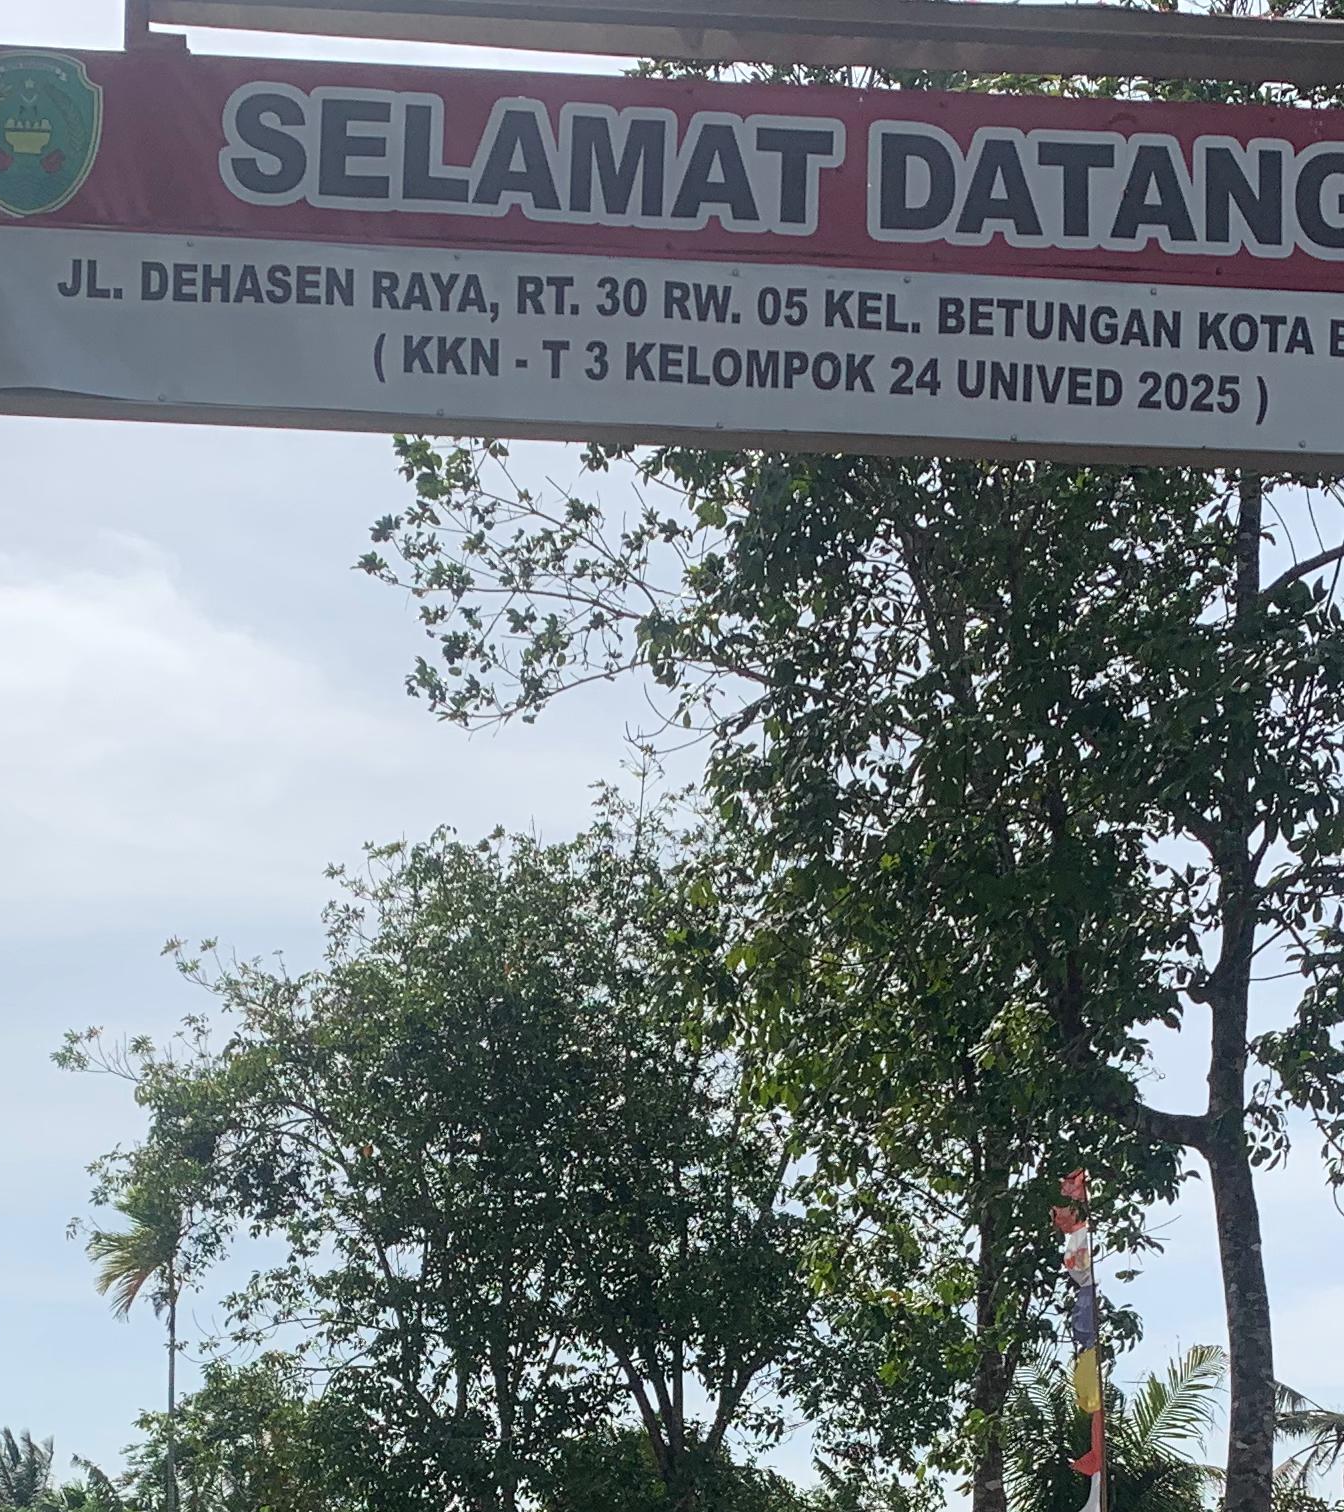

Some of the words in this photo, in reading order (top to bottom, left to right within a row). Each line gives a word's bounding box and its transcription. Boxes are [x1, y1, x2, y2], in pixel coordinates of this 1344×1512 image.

[229, 92, 835, 225] SELAMAT
[57, 258, 123, 300] JL.
[140, 260, 355, 307] DEHASEN
[372, 270, 500, 324] RAYA,
[516, 275, 580, 316] RT.
[595, 276, 648, 318] 30
[663, 280, 741, 325] RW.
[757, 286, 808, 327] 05
[824, 289, 921, 334] KEL.
[937, 296, 1182, 349] BETUNGAN
[1198, 311, 1315, 356] KOTA
[403, 334, 500, 377] KKN
[542, 339, 570, 379] T
[584, 340, 609, 381] 3
[625, 341, 876, 393] KELOMPOK
[889, 356, 942, 397] 24
[957, 358, 1123, 407] UNIVED
[1137, 370, 1241, 414] 2025
